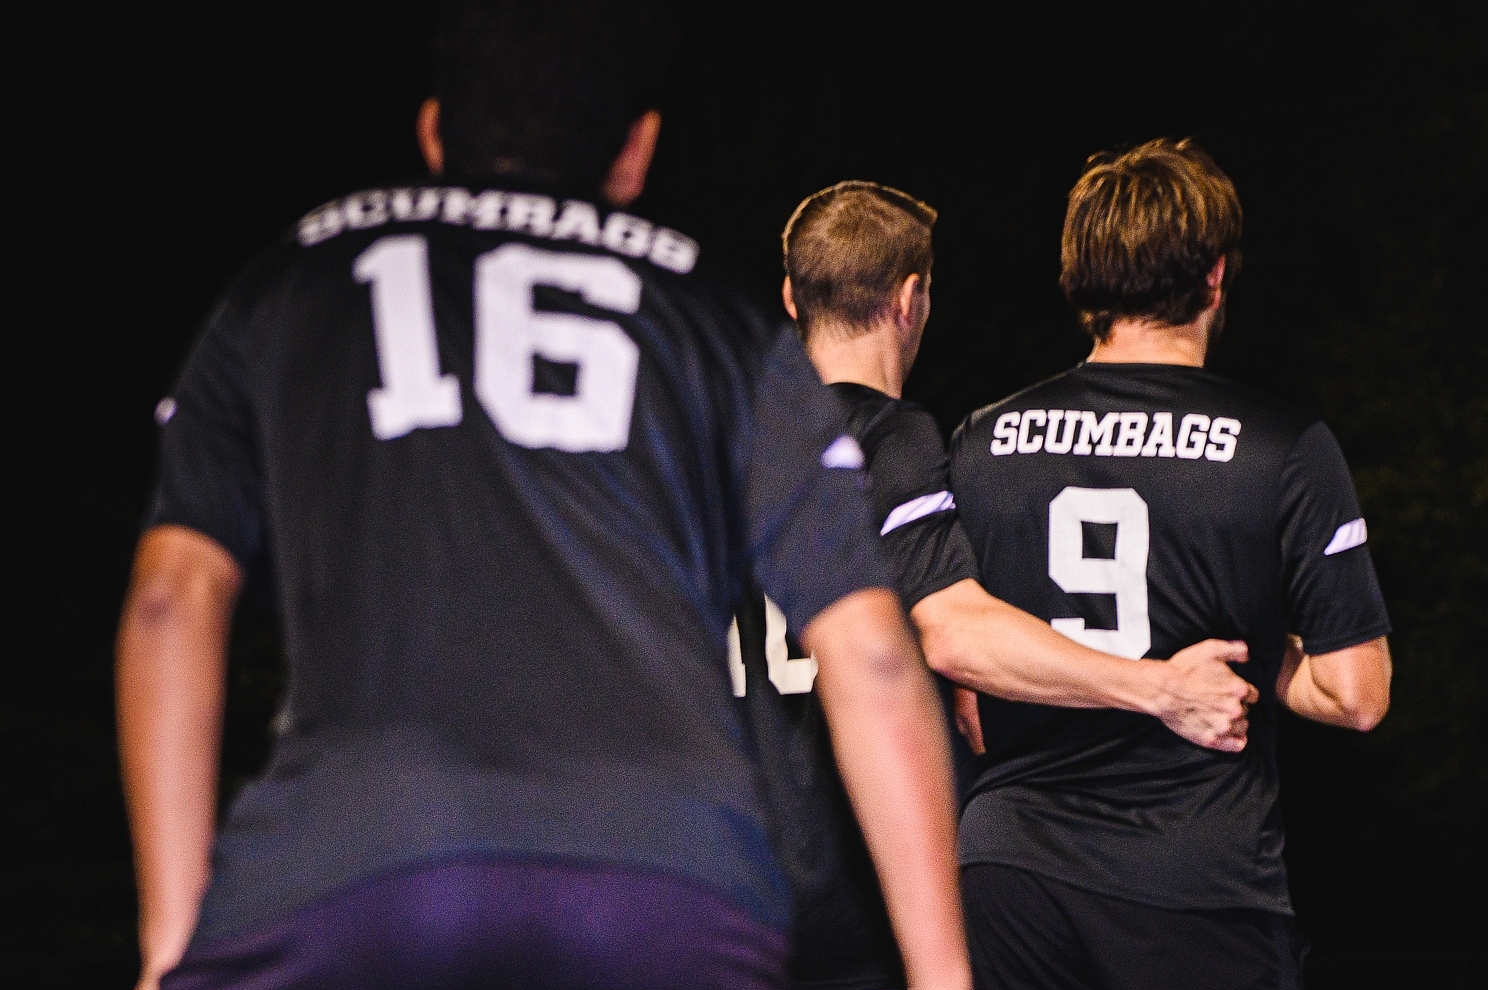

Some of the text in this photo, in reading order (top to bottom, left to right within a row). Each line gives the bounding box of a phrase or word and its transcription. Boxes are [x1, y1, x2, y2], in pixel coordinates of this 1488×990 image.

[352, 234, 642, 452] 16
[990, 409, 1241, 462] SCUMBAGS
[1048, 486, 1151, 660] 9
